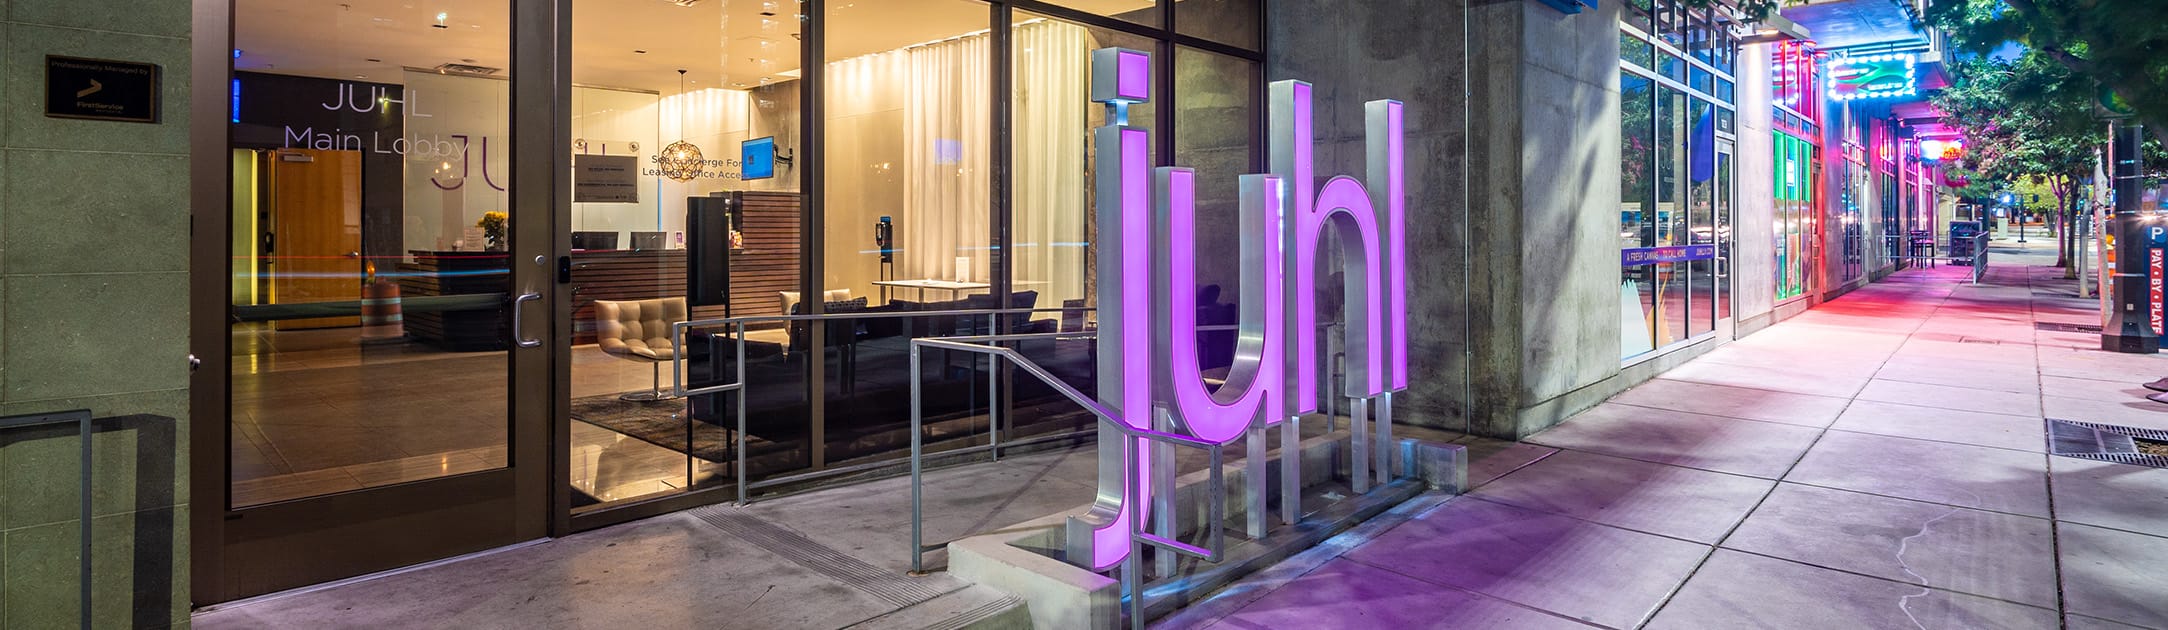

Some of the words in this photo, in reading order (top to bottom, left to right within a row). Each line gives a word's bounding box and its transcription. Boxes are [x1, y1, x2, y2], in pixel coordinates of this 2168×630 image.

[322, 83, 432, 118] JUHL
[284, 126, 361, 151] Main
[374, 131, 469, 161] Lobby
[726, 159, 742, 168] For
[2151, 226, 2164, 240] P
[2151, 249, 2163, 268] PAY
[2151, 278, 2162, 293] BY
[1068, 47, 1408, 571] juhl
